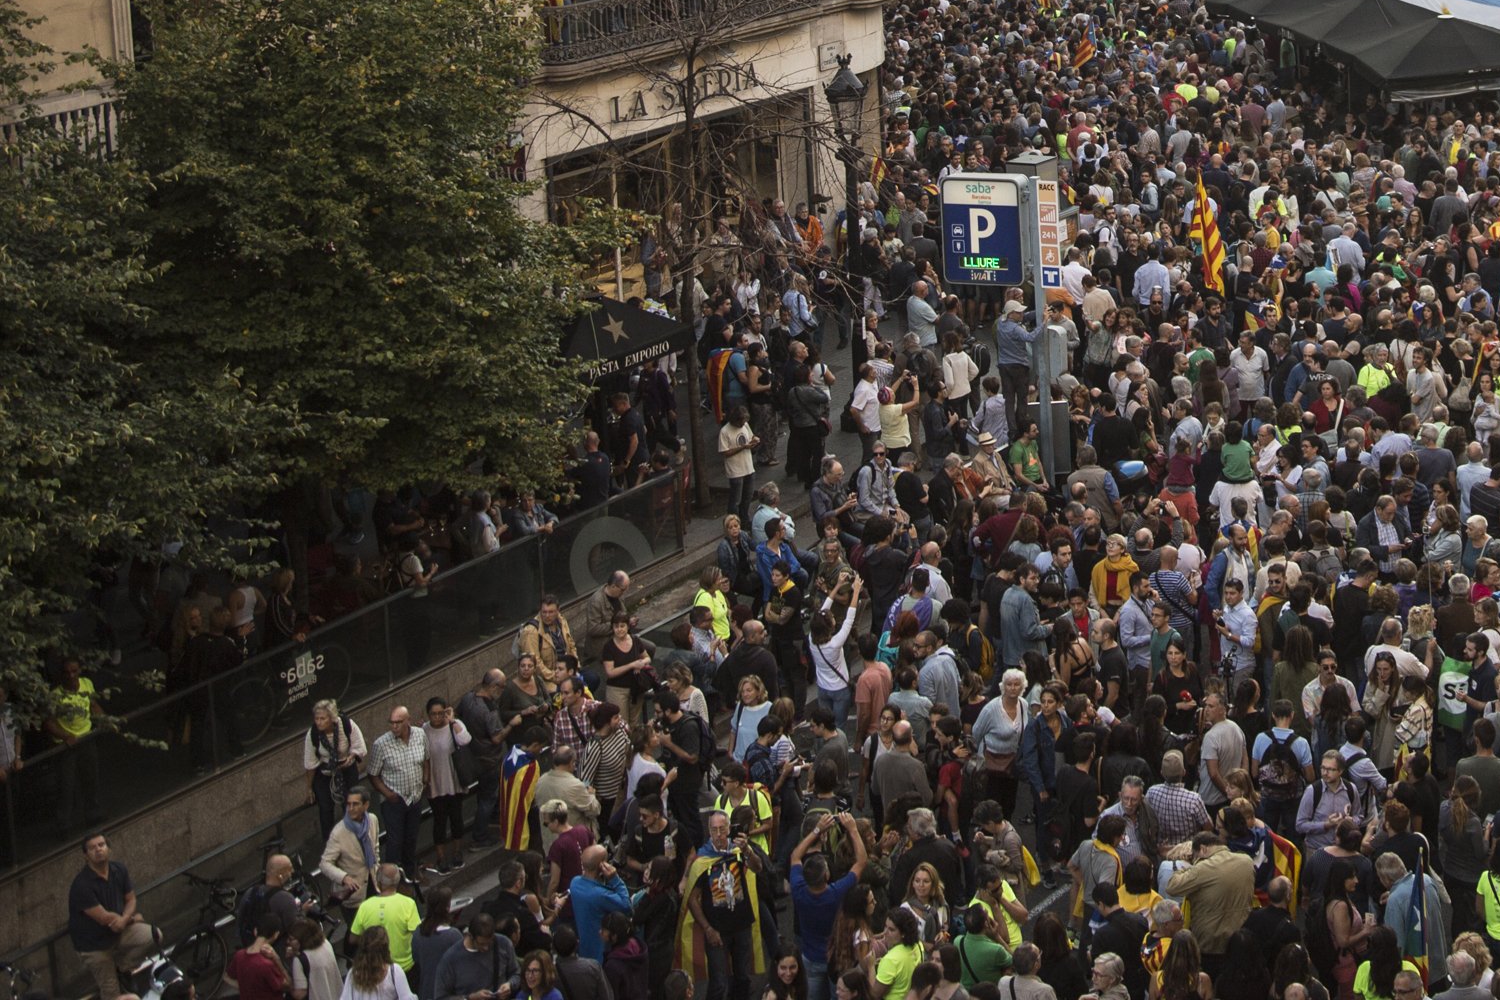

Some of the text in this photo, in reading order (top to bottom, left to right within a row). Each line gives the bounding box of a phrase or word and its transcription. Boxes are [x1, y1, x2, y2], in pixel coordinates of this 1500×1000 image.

[610, 90, 648, 124] LA
[969, 208, 997, 254] P
[964, 256, 1000, 269] LLIURE
[588, 340, 670, 380] PASTA EMPORIO
